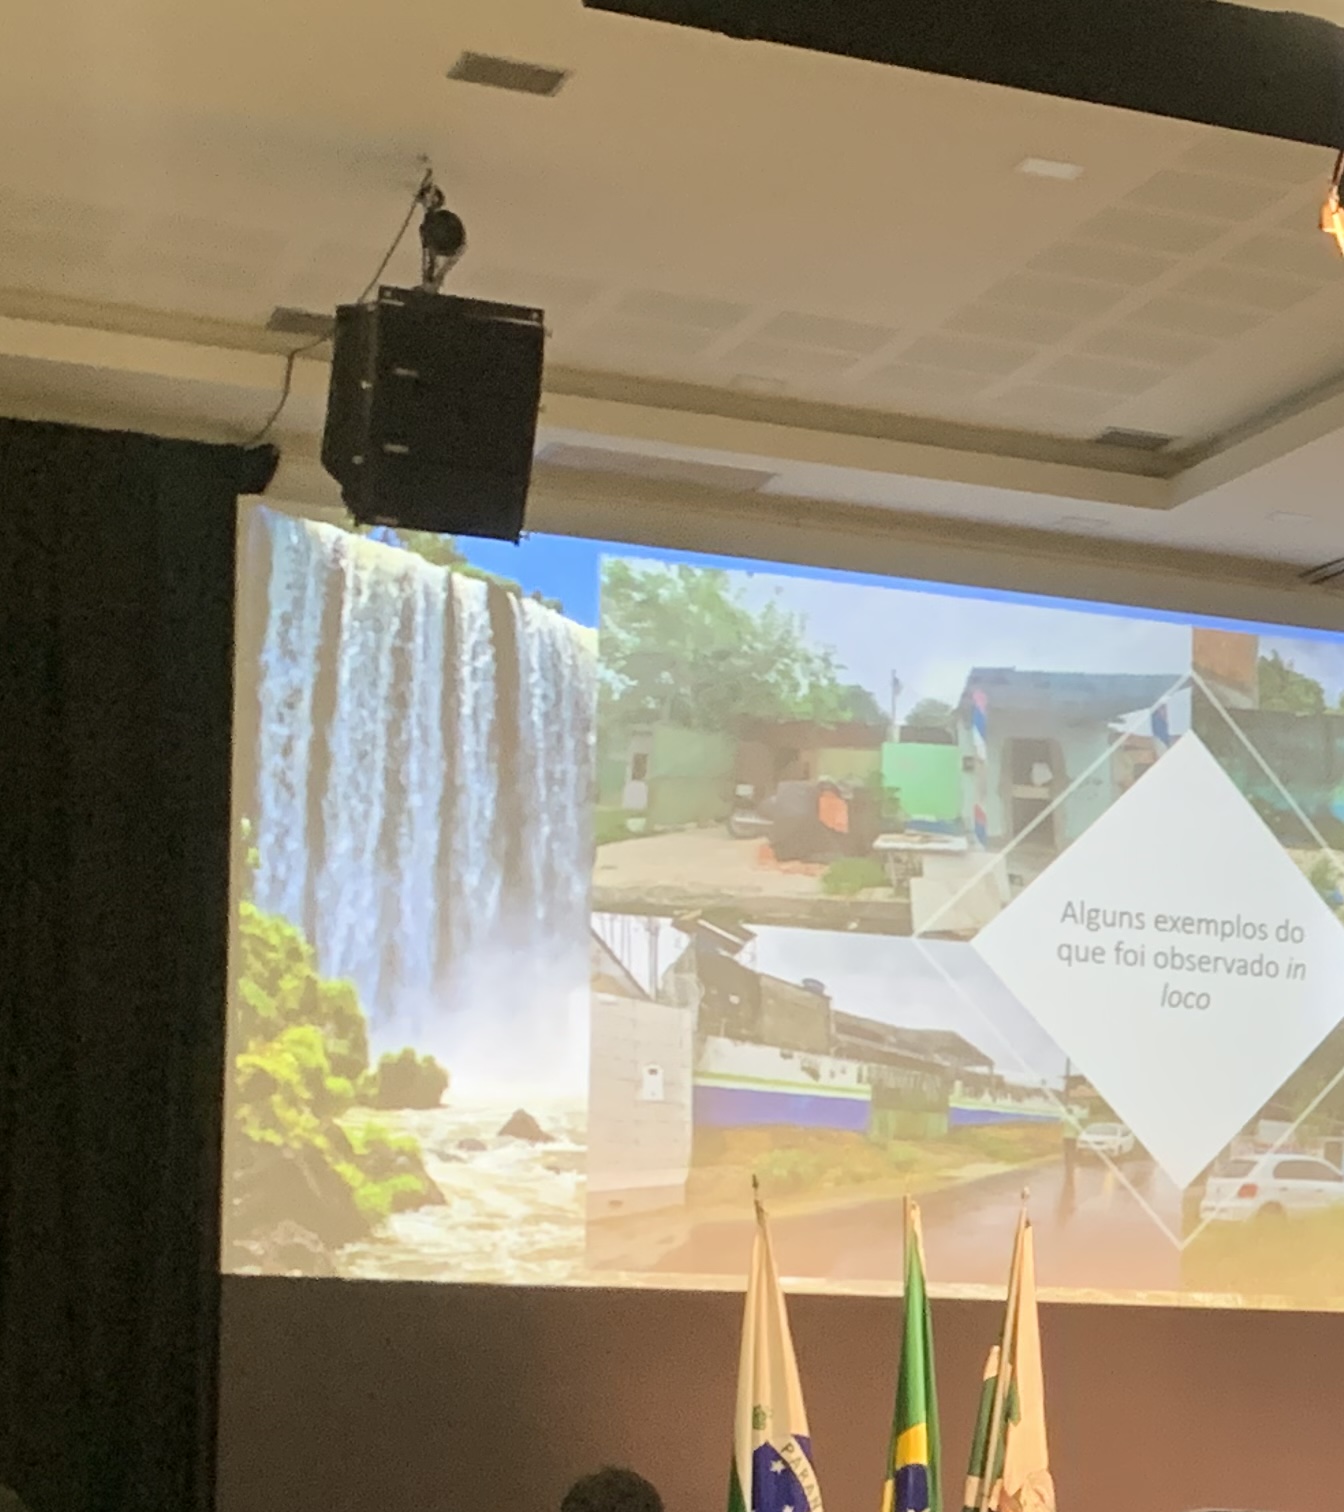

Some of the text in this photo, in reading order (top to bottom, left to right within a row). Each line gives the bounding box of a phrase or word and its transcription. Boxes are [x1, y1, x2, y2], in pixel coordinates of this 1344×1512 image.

[1060, 900, 1305, 944] Alguns exemplos do
[1057, 940, 1307, 980] que foi observado in
[1160, 982, 1212, 1010] loco
